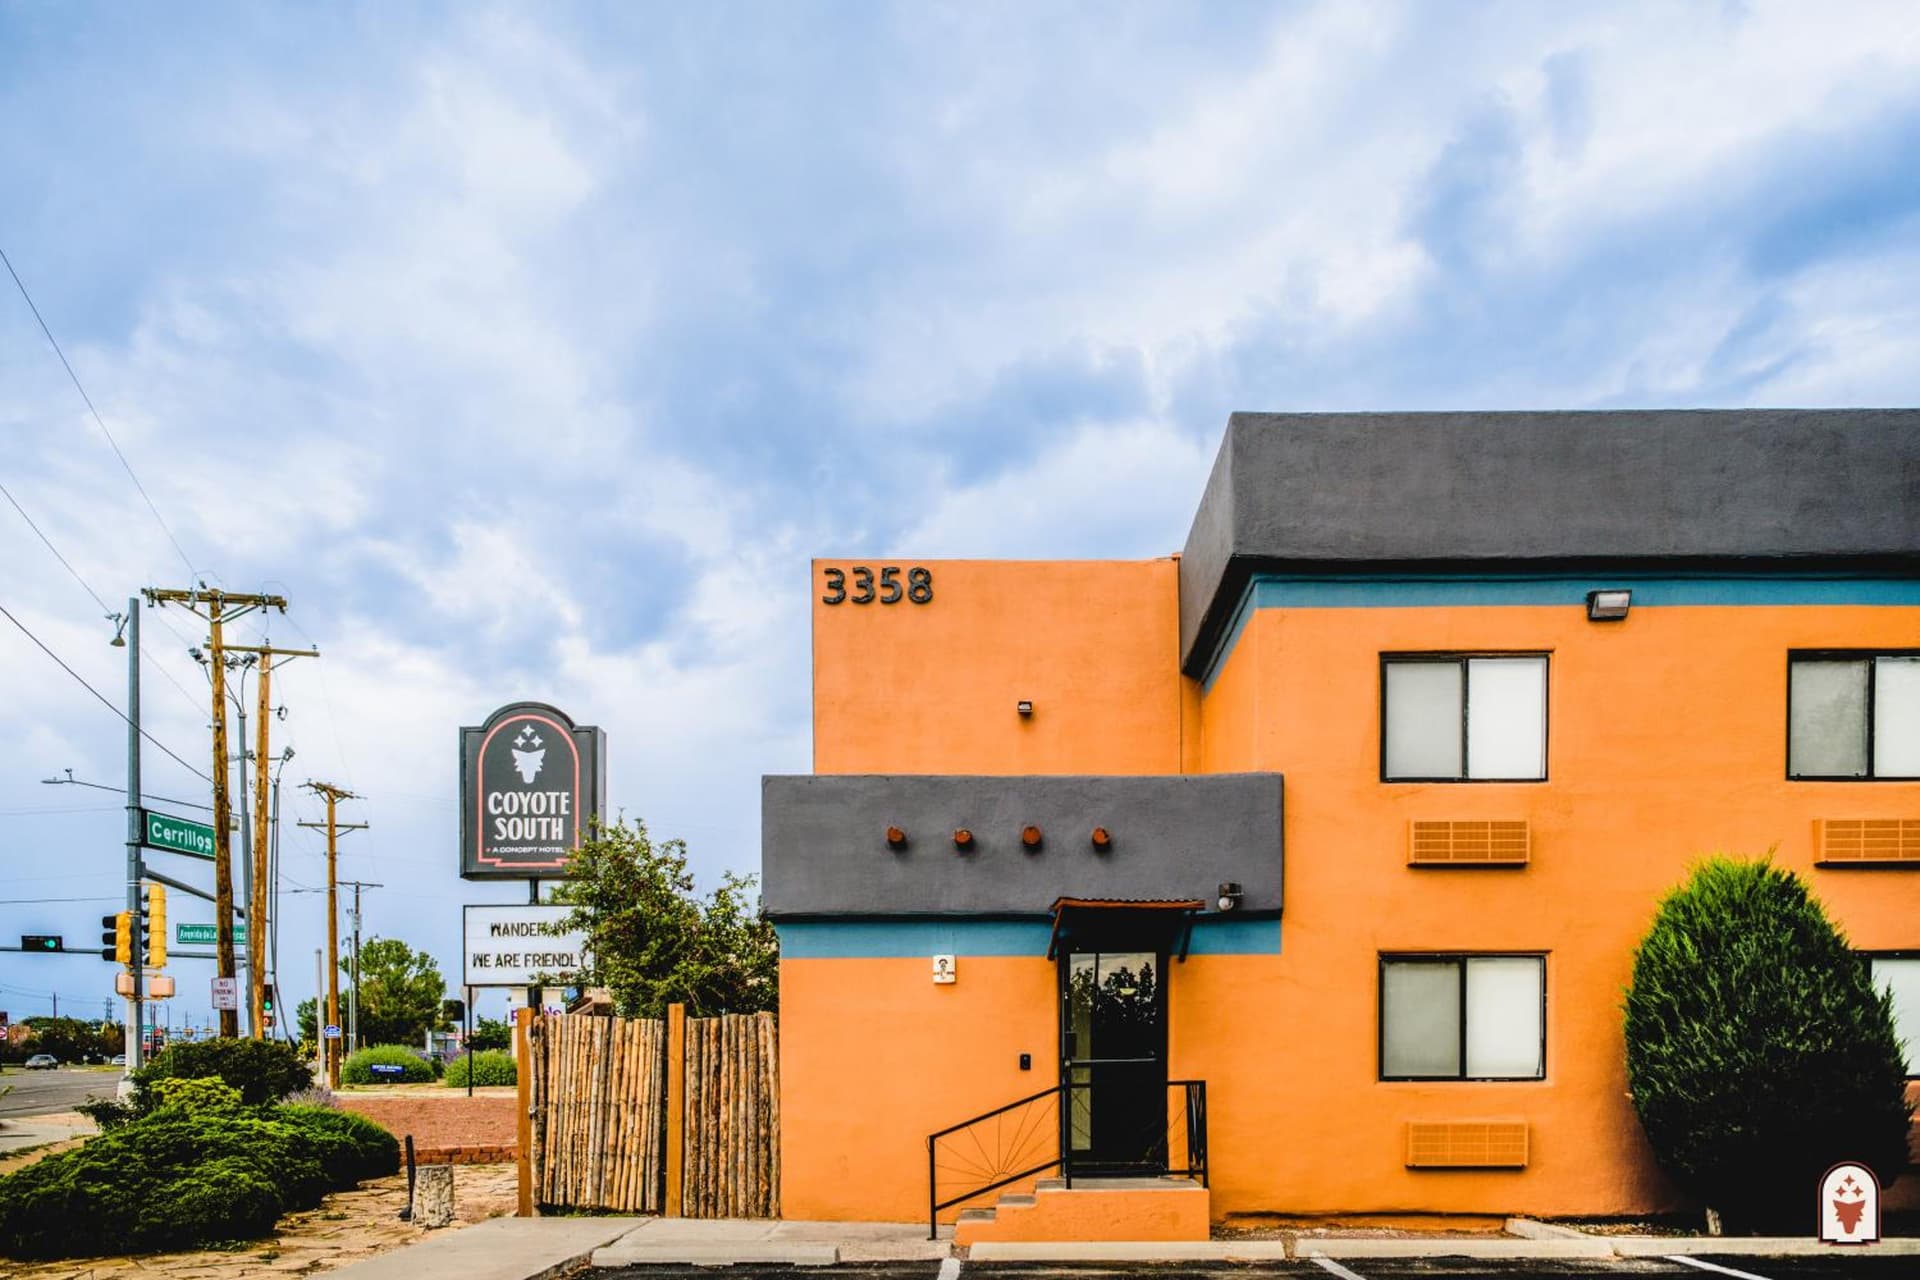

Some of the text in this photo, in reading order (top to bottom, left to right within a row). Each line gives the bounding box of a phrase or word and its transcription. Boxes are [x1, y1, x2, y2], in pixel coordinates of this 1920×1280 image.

[822, 567, 933, 605] 3358
[488, 791, 570, 815] COYOTE
[152, 822, 212, 850] Cerrillos
[494, 817, 564, 840] SOUTH
[473, 953, 491, 968] WE
[495, 953, 520, 968] ARE
